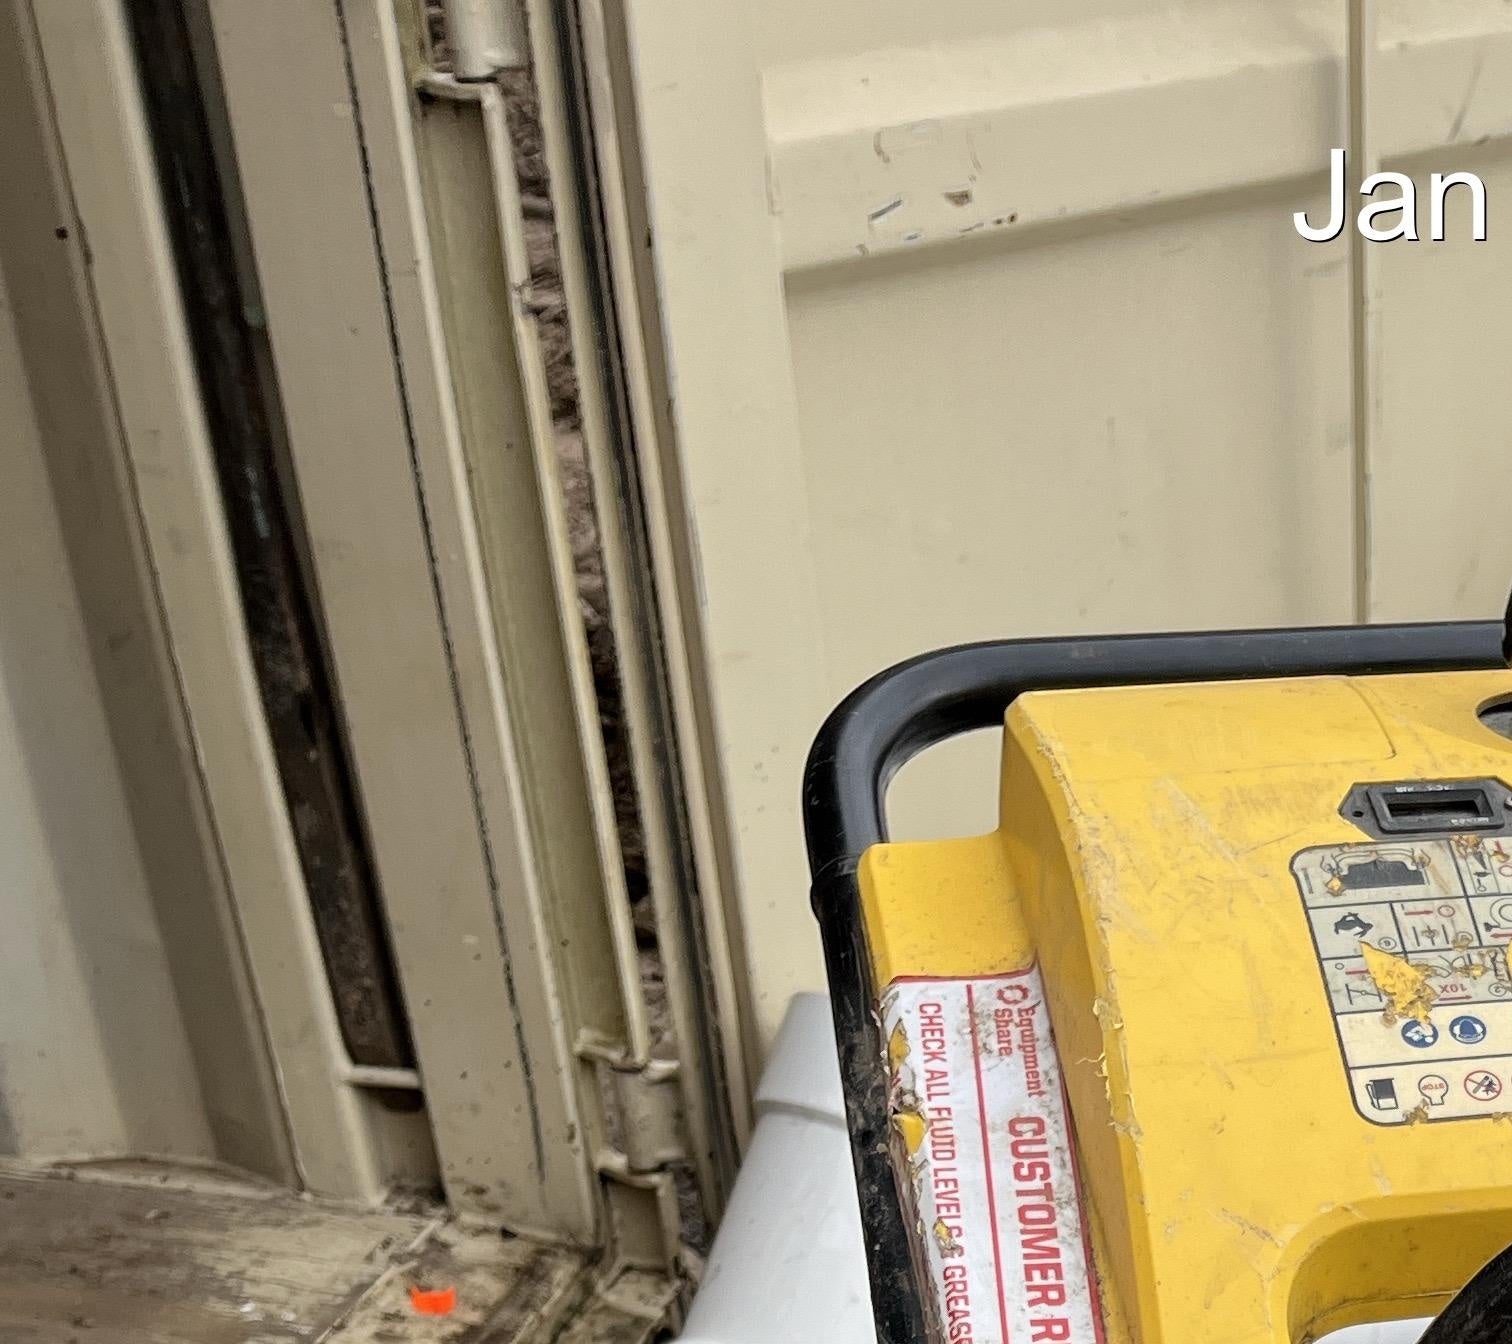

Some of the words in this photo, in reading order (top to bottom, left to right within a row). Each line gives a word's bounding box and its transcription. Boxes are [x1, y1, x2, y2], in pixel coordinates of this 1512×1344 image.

[1439, 983, 1468, 994] 10X
[919, 1003, 948, 1064] CHECK
[995, 1008, 1013, 1057] Share
[1018, 1007, 1045, 1097] Equipment
[925, 1070, 951, 1102] ALL
[1423, 1082, 1445, 1092] STOP
[928, 1107, 957, 1161] FLUID
[1008, 1116, 1067, 1308] CUSTOMER
